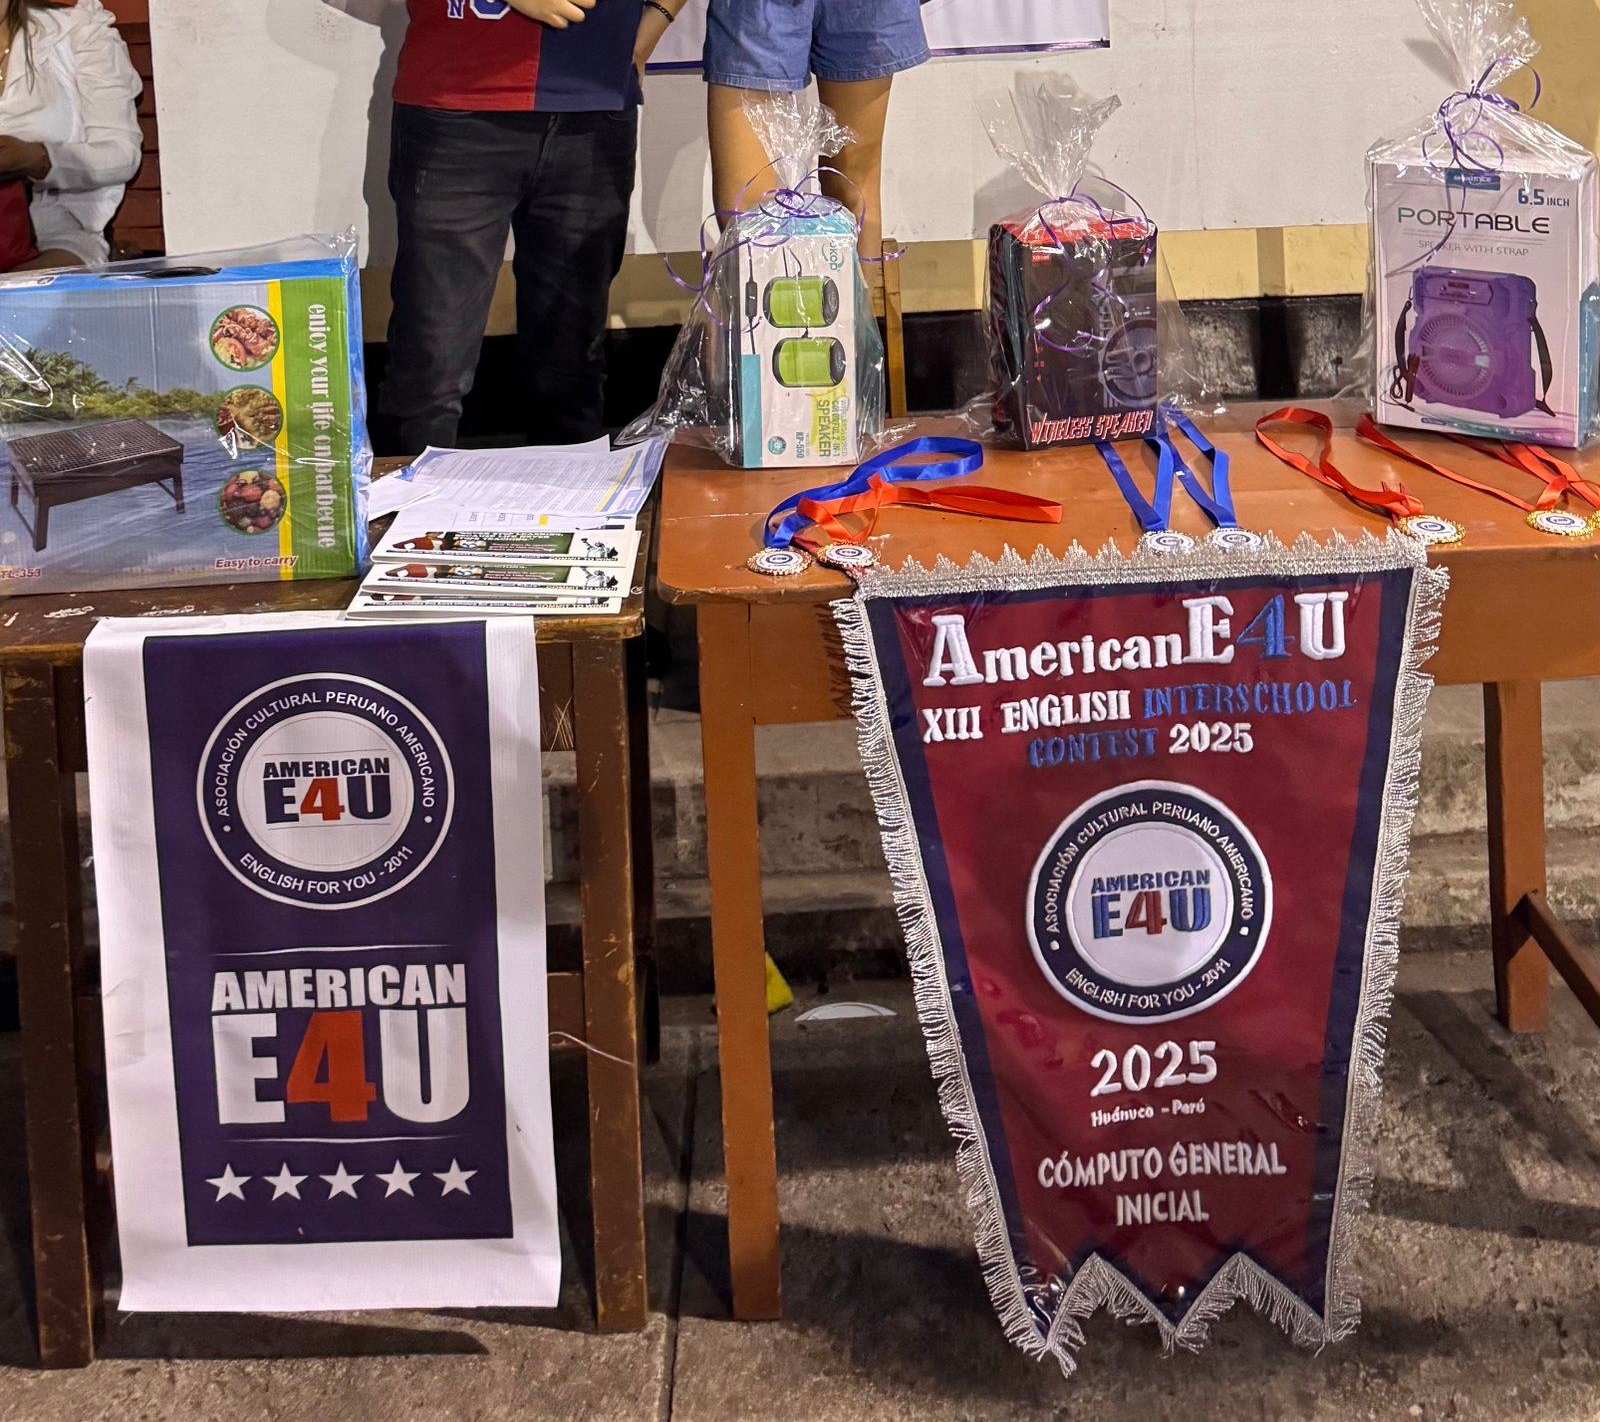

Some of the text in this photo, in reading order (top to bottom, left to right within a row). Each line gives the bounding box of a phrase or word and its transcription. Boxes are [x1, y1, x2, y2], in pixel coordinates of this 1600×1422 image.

[1517, 187, 1570, 207] 6.5 INCH
[1398, 207, 1550, 234] PORTABLE
[1464, 244, 1493, 254] WITH
[1497, 246, 1529, 257] STRAP
[308, 304, 330, 352] enjoy
[310, 356, 329, 398] your
[311, 401, 336, 431] life
[818, 399, 831, 457] SPEAKER
[1031, 410, 1154, 444] WIRELESS SPEAKER
[313, 434, 331, 457] on
[215, 555, 298, 569] Easy to carry
[922, 679, 1358, 744] XIII ENGLISH INTERSCHOOL
[215, 691, 435, 816] ASOCIACIÓN CULTURAL PERUANO AMERICANO
[1028, 721, 1255, 768] CONTEST 2025
[263, 757, 390, 779] AMERICAN
[263, 775, 392, 824] E4U
[240, 853, 304, 892] ENGLISH
[306, 881, 340, 894] FOR
[342, 872, 376, 892] YOU
[384, 845, 413, 873] 2011
[1044, 801, 1254, 934] ASOCIACIÓN CULTURAL PERUANO AMERICANO
[1091, 869, 1211, 894] AMERICAN
[1092, 887, 1212, 940] E4U
[211, 963, 467, 1012] AMERICAN
[1065, 967, 1126, 1008] ENGLISH
[1127, 993, 1161, 1009] FOR
[1164, 983, 1195, 1006] YOU
[211, 1007, 470, 1124] E4U
[1090, 1040, 1218, 1098] 2025
[1090, 1105, 1154, 1128] Huánuco
[1038, 1141, 1288, 1189] CÓMPUTO GENERAL
[1116, 1189, 1210, 1227] INICIAL
